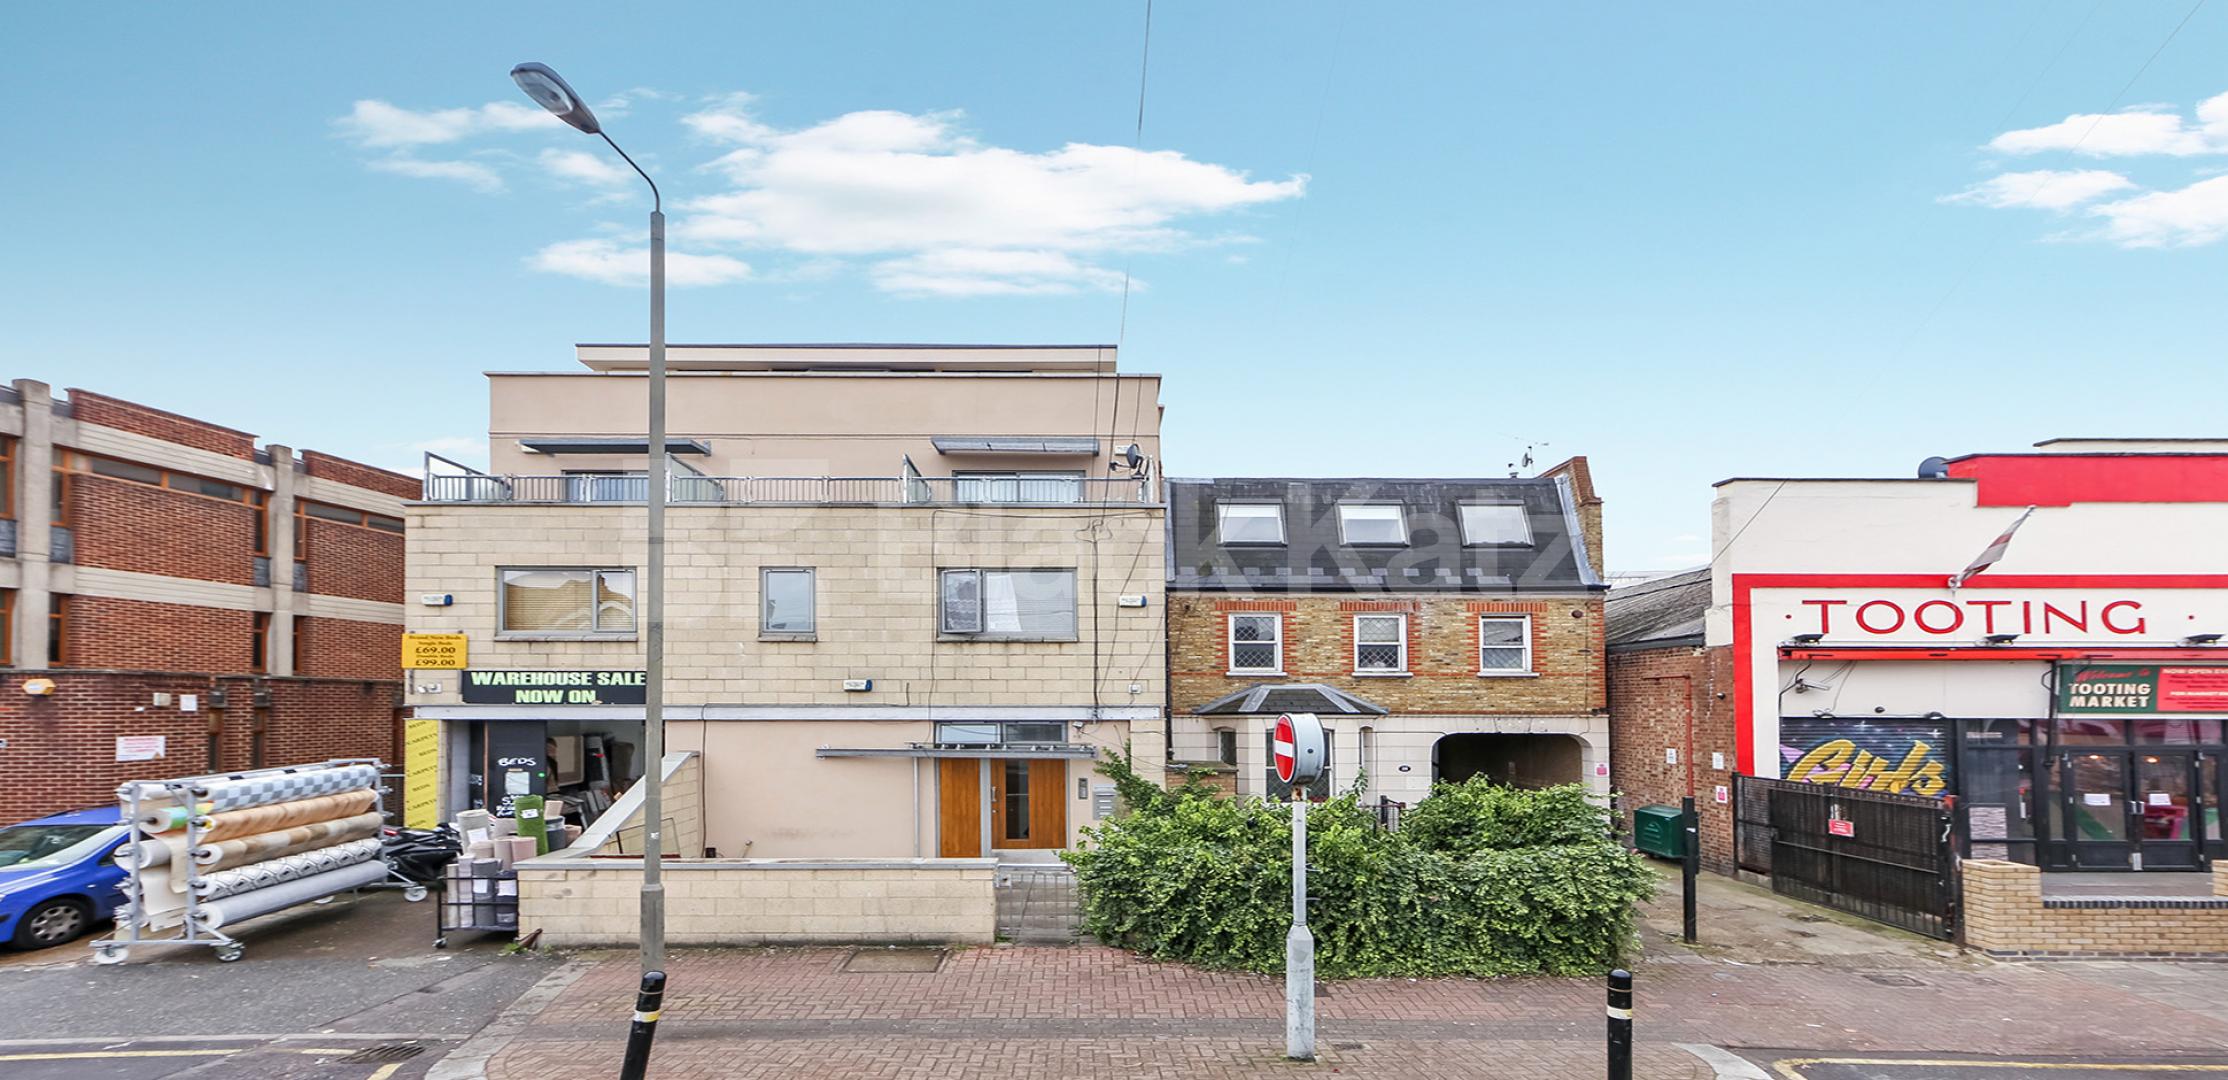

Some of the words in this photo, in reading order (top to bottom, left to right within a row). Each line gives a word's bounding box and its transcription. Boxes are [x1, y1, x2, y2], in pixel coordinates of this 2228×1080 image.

[1802, 599, 2147, 635] TOOTING
[416, 646, 456, 654] £69.00
[470, 672, 593, 686] WAREHOUSE
[597, 672, 647, 686] SALE
[2068, 683, 2152, 695] TOOTING
[515, 690, 564, 703] NOW
[568, 690, 597, 703] ON
[2069, 696, 2150, 707] MARKET
[498, 757, 537, 767] BEDS
